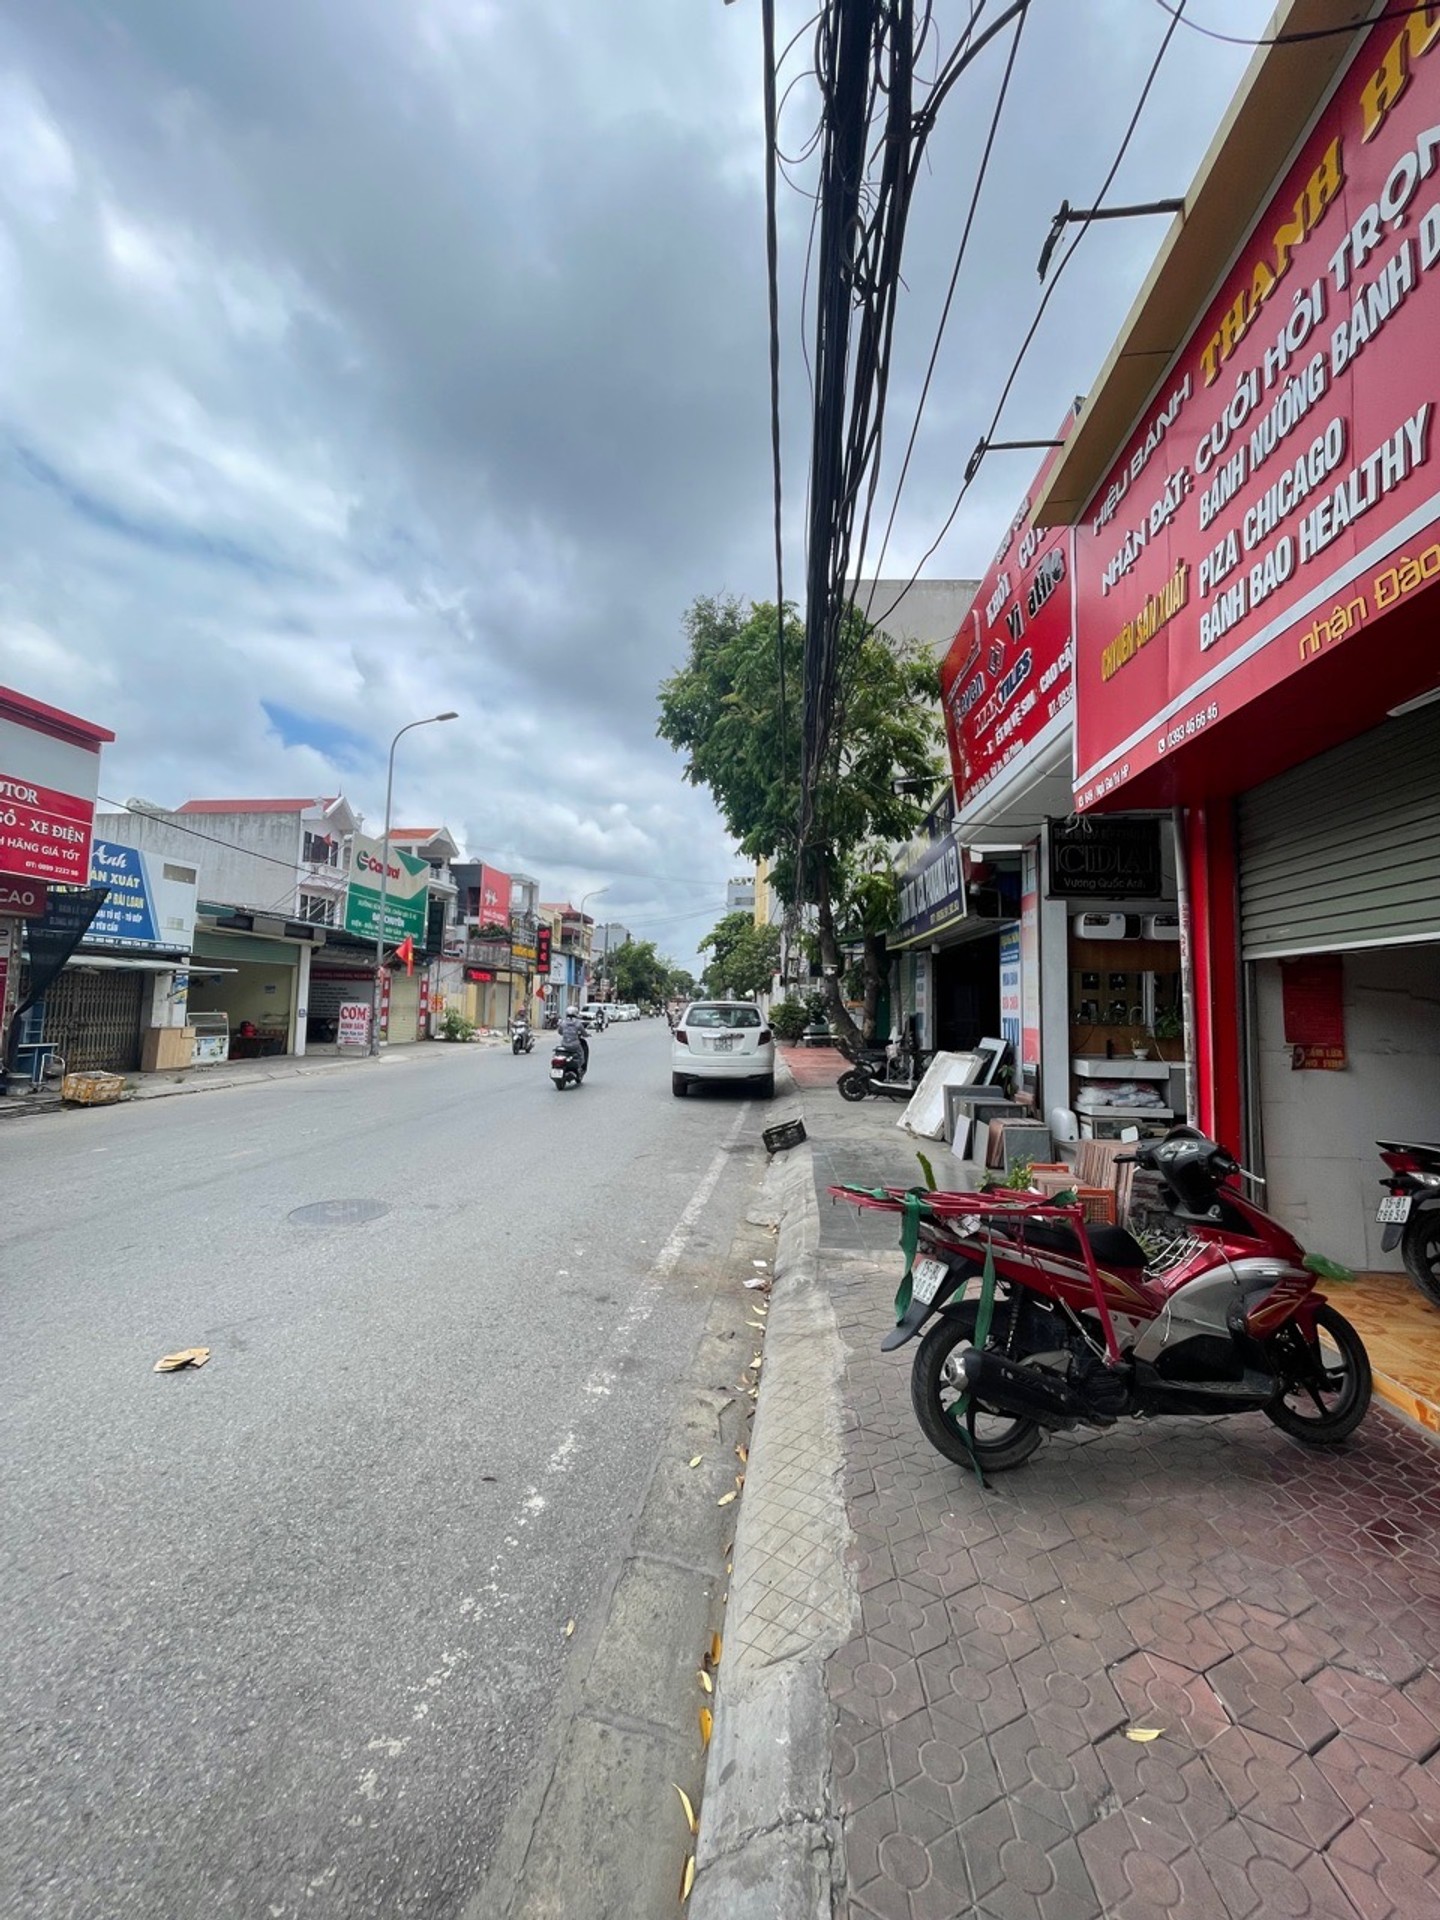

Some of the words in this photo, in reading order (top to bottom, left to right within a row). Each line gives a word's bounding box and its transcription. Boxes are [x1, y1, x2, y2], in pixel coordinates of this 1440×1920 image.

[1131, 372, 1191, 480] BÁNH
[1200, 136, 1344, 388] THANH
[1102, 517, 1148, 596] NHẬN
[1195, 367, 1260, 474] CƯỚI
[1264, 277, 1325, 389] HỎI
[1200, 445, 1248, 531] BÁNH
[1250, 352, 1327, 472] NƯỚNG
[1331, 238, 1414, 378] BÁNH
[1200, 529, 1241, 598] PIZA
[1243, 416, 1345, 551] CHICAGO
[1200, 583, 1246, 652] BÁNH
[1249, 535, 1294, 609] BAO
[1299, 402, 1434, 564] HEALTHY
[1102, 622, 1137, 682] CHUYÊN
[1136, 594, 1158, 648] SẢN
[1158, 558, 1190, 629] XUẤT
[1300, 596, 1367, 660] nhận
[1374, 544, 1440, 610] Đào
[1207, 702, 1218, 719] 46
[7, 838, 39, 853] HÃNG
[41, 844, 59, 858] GIÁ
[61, 849, 80, 862] TỐT
[30, 820, 49, 835] XE
[52, 825, 84, 844] ĐIỆN
[110, 872, 140, 889] XUẤT
